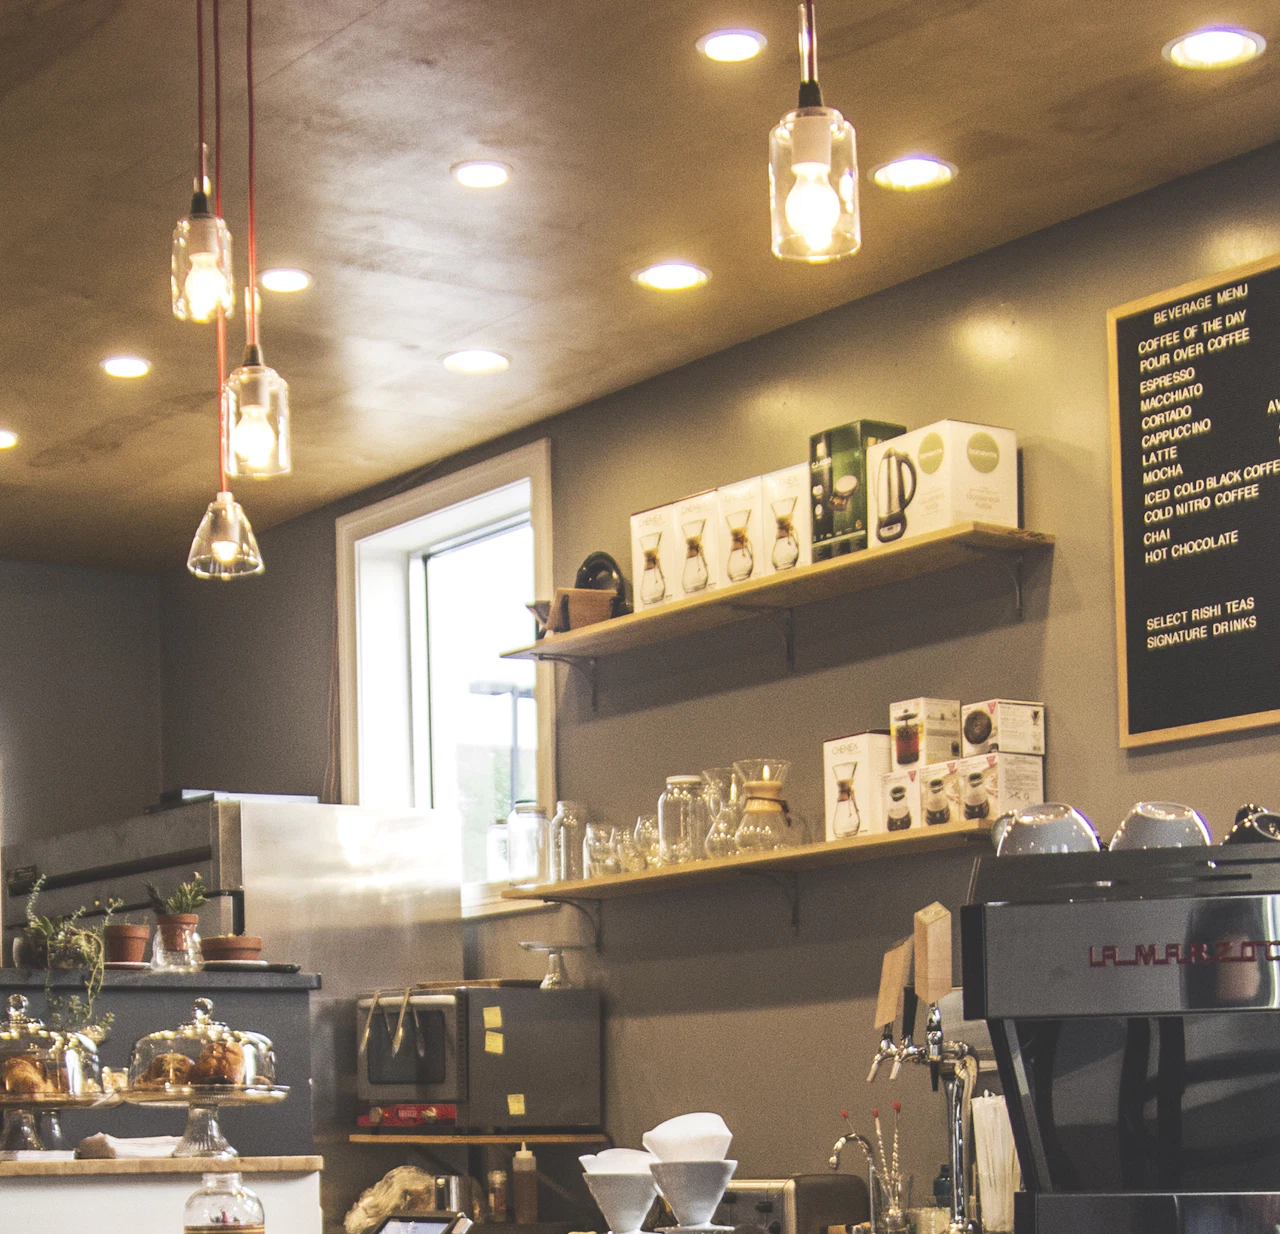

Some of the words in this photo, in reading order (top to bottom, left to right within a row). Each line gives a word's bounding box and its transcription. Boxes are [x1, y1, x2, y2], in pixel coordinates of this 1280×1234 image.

[1153, 295, 1212, 325] BEVERAGE
[1217, 283, 1248, 304] MENU
[1138, 331, 1180, 354] COFFEE
[1183, 325, 1198, 339] OF
[1202, 317, 1223, 334] THE
[1225, 309, 1247, 327] DAY
[1140, 353, 1170, 373] POUR
[1173, 342, 1204, 362] OVER
[1207, 327, 1250, 351] COFFEE
[1140, 367, 1195, 394] ESPRESSO
[1141, 383, 1203, 412] MACCHIATO
[1141, 405, 1192, 429] CORTADO
[1141, 418, 1211, 448] CAPPUCCINO
[1142, 446, 1177, 466] LATTE
[1143, 463, 1183, 484] MOCHA
[1144, 488, 1170, 505] ICED
[1174, 480, 1204, 498] COLD
[1206, 470, 1241, 490] BLACK
[1144, 506, 1173, 524] COLD
[1176, 496, 1211, 516] NITRO
[1214, 484, 1259, 505] COFFEE
[1143, 528, 1170, 545] CHAI
[1145, 547, 1168, 563] HOT
[1171, 530, 1239, 557] CHOCOLATE
[1146, 611, 1188, 630] SELECT
[1192, 604, 1221, 621] RISHI
[1225, 597, 1255, 614] TEAS
[1147, 626, 1207, 648] SIGNATURE
[1213, 616, 1257, 636] DRINKS
[831, 742, 859, 755] CHEMEX
